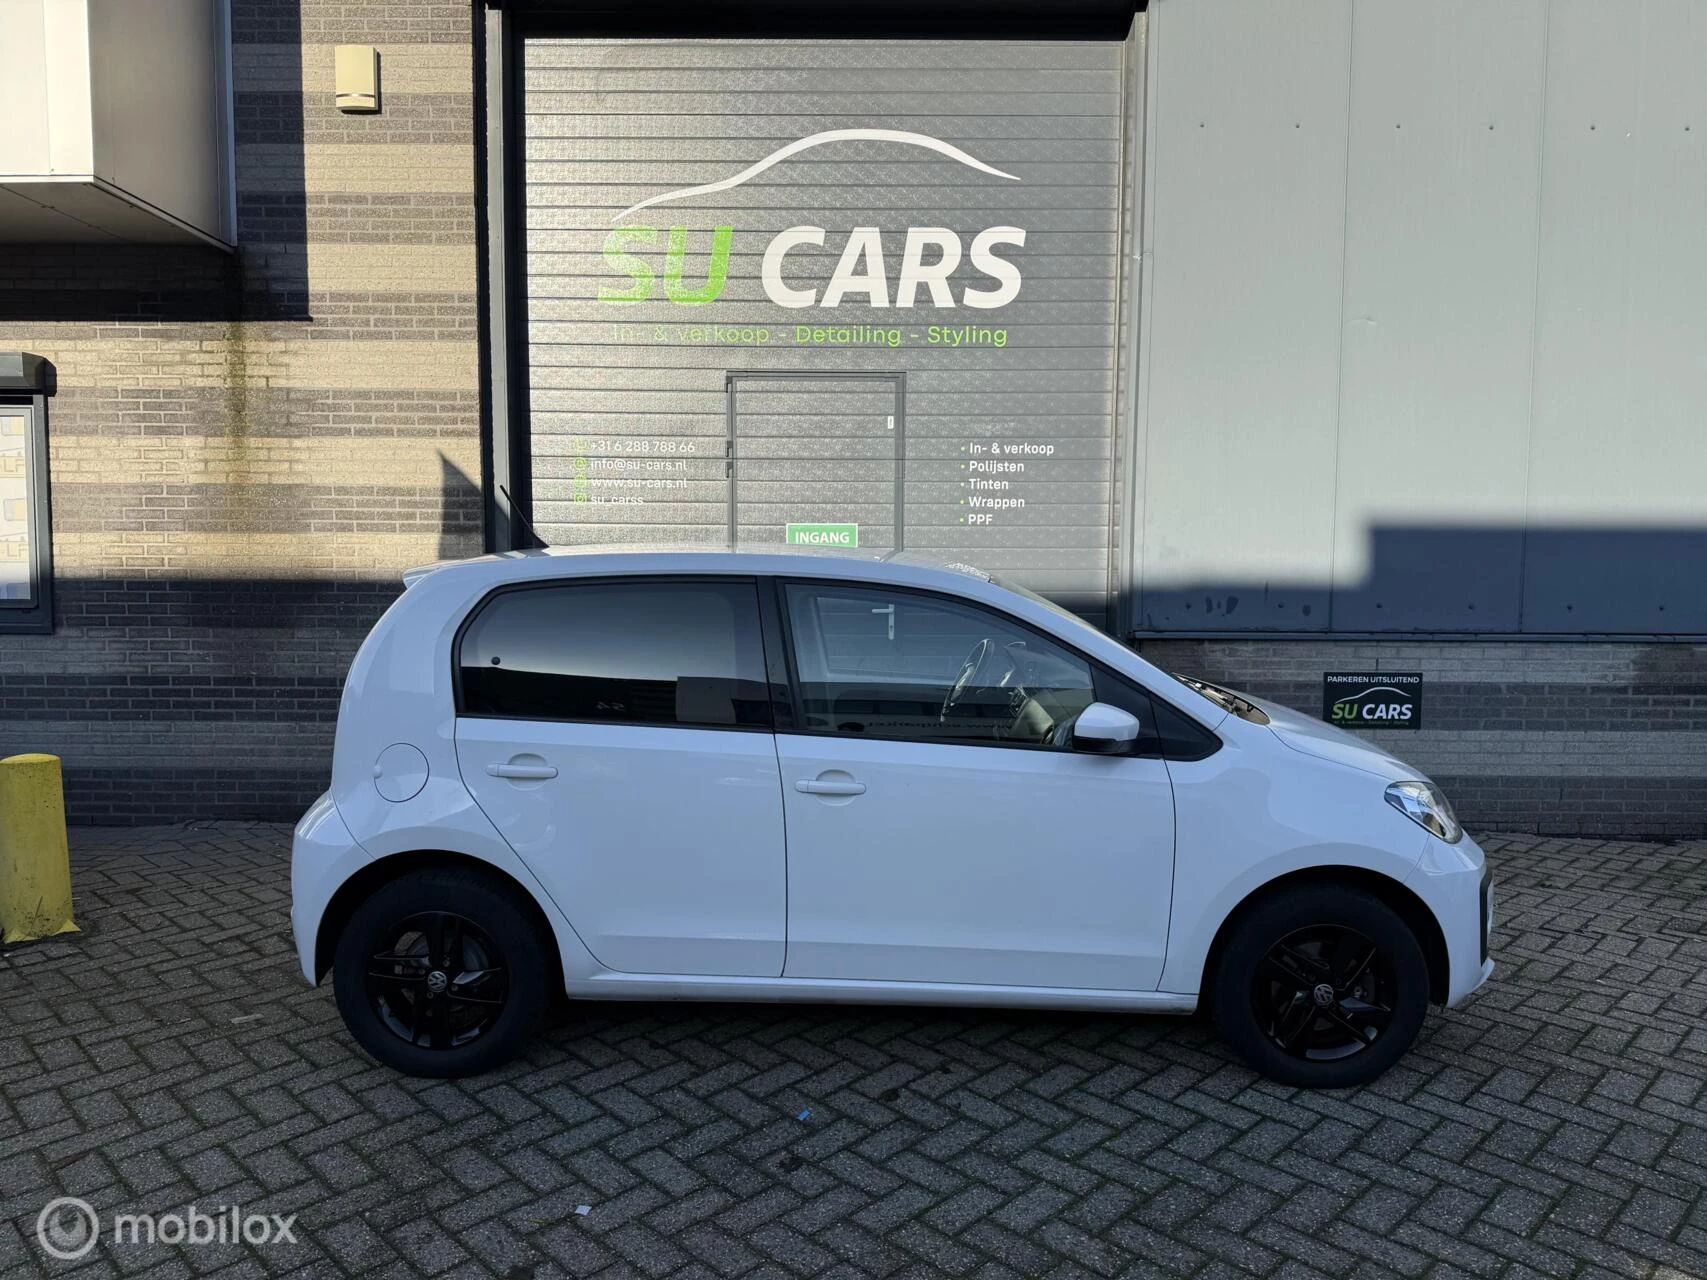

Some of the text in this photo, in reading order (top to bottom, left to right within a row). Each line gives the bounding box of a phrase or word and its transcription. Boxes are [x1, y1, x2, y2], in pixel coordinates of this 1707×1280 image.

[597, 225, 1027, 308] SU CARS
[655, 325, 667, 341] &
[678, 325, 769, 345] verkoop
[796, 326, 901, 347] Detailing
[927, 326, 1008, 347] Styling
[591, 441, 695, 452] +31 6 288 788 66
[969, 442, 1054, 456] In- & verkoop
[591, 459, 687, 471] info@su-cars.nl
[969, 460, 1025, 474] Polijsten
[591, 477, 688, 488] www.su-cars.nl
[968, 478, 1009, 490] Tinten
[968, 496, 1025, 510] Wrappen
[968, 514, 993, 525] PPF
[795, 531, 850, 544] INGANG
[1327, 675, 1420, 684] PARKEREN UITSLUITEND
[1331, 703, 1413, 720] SU CARS
